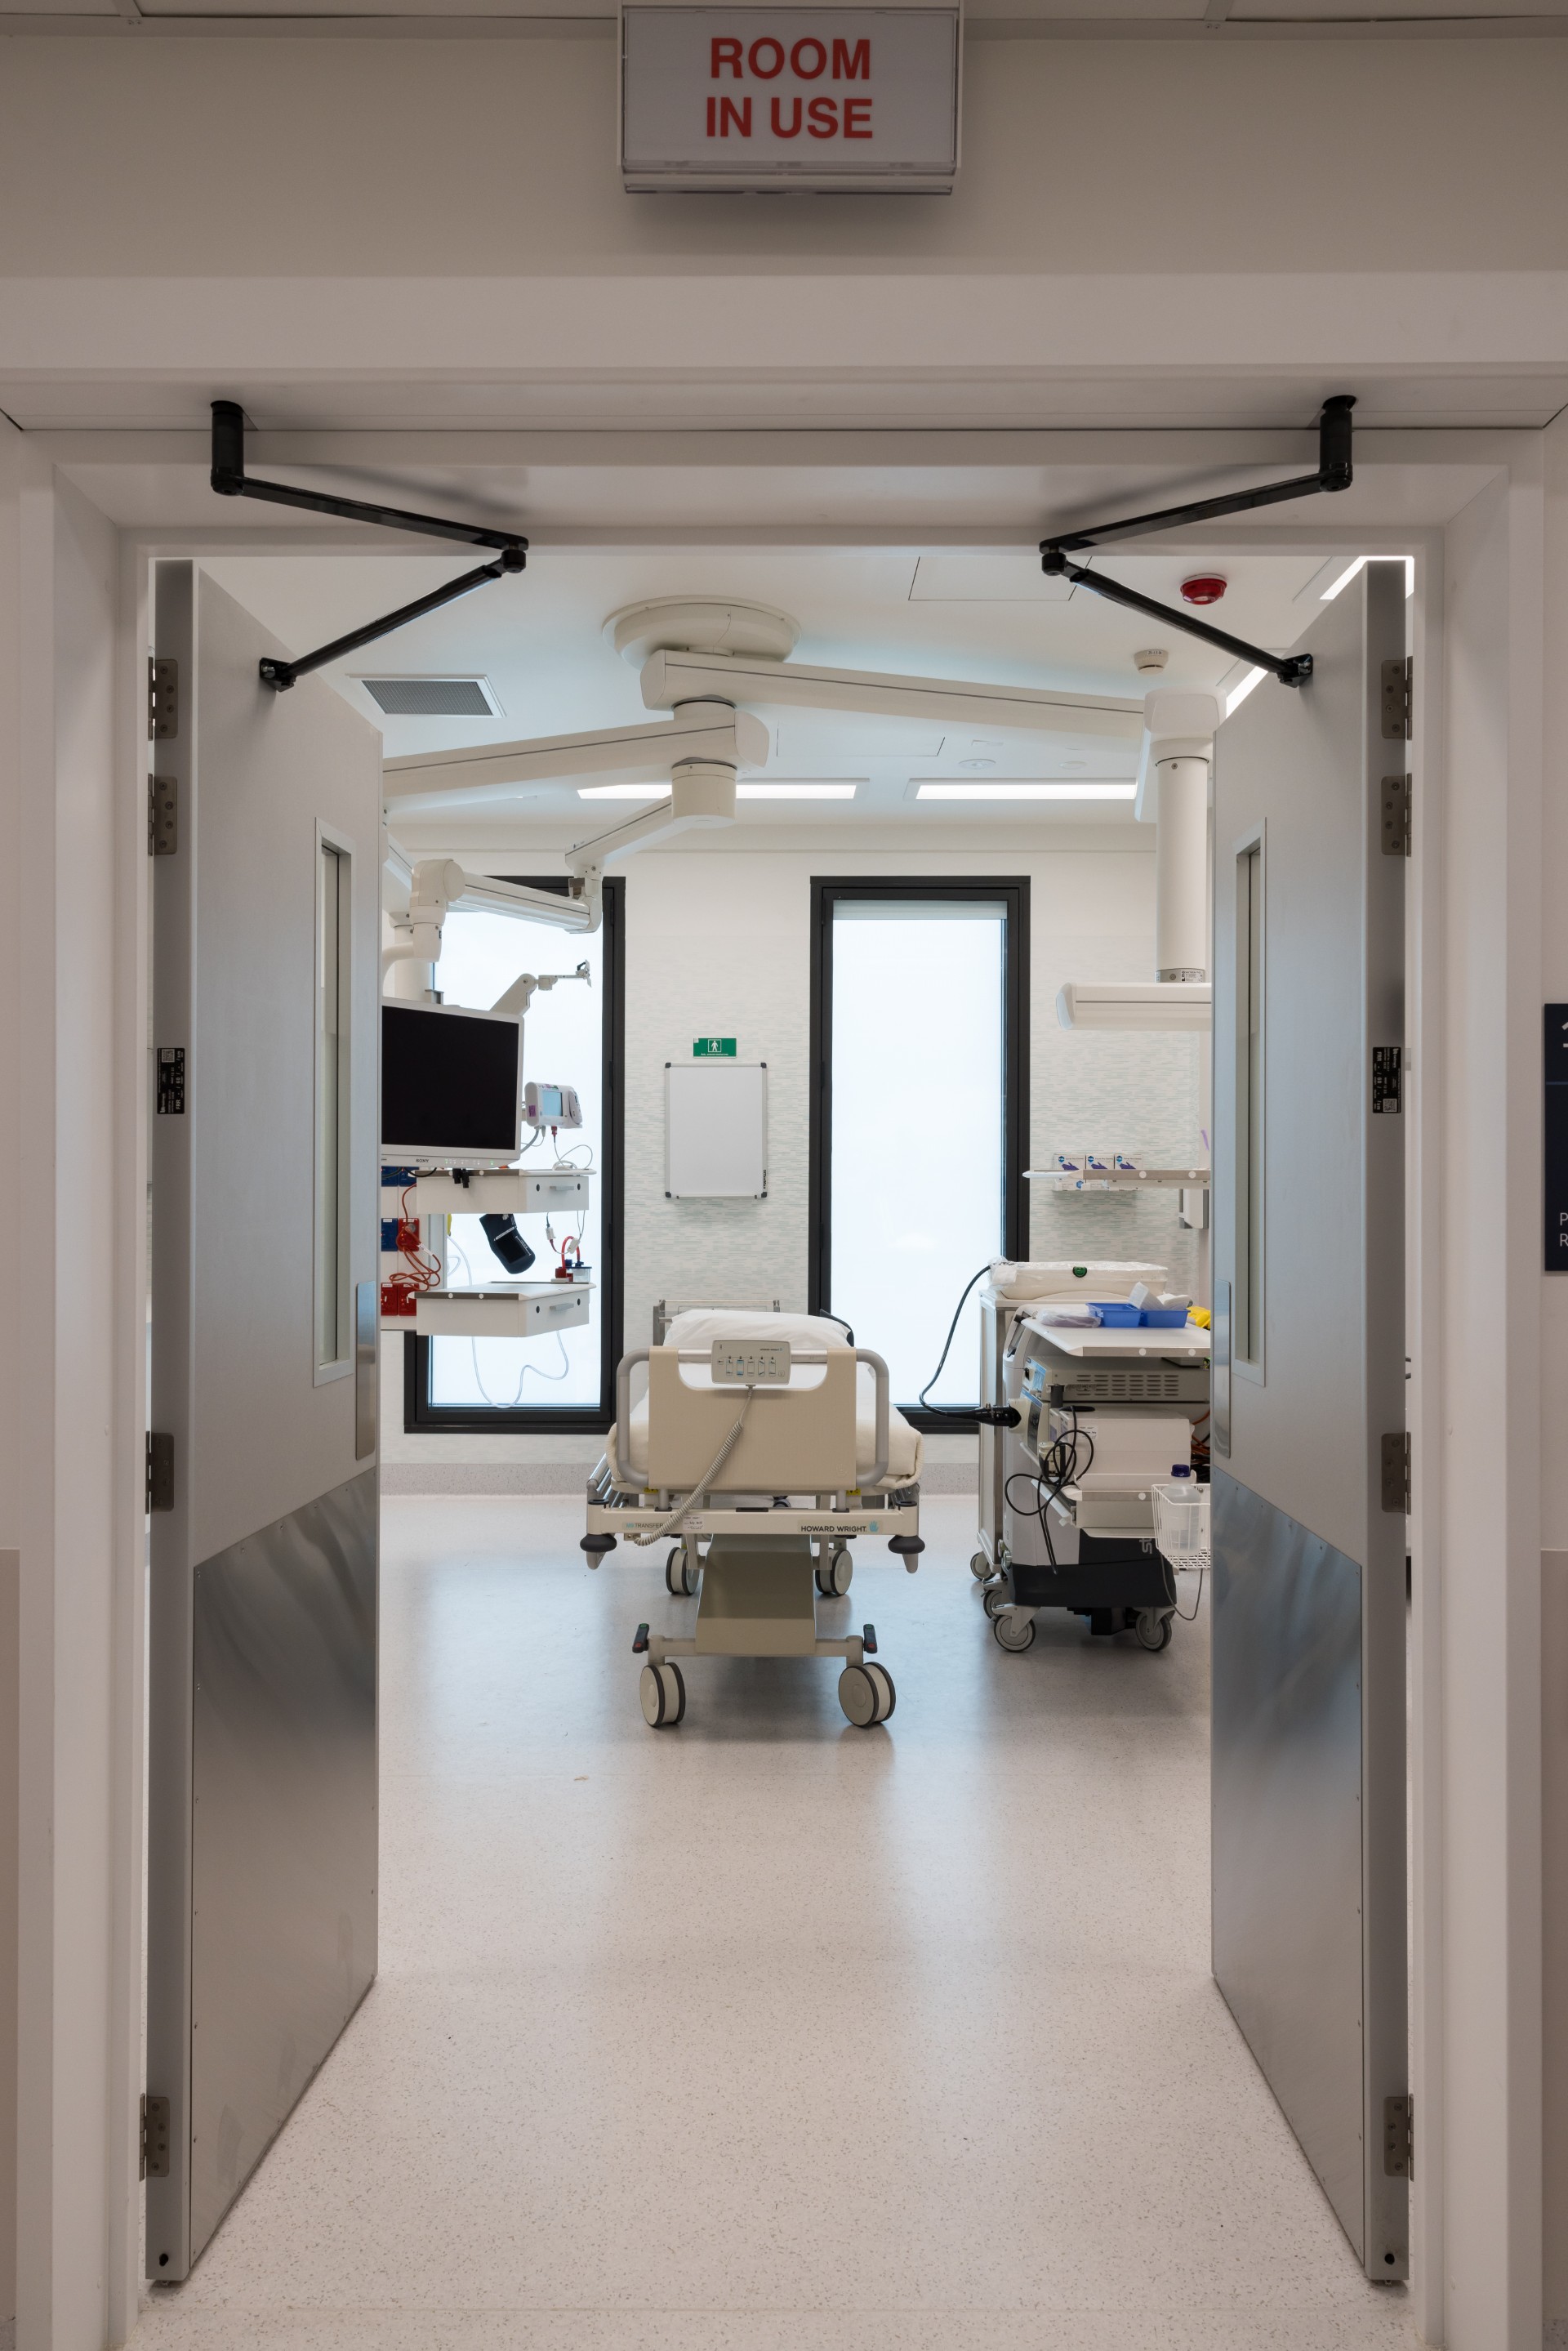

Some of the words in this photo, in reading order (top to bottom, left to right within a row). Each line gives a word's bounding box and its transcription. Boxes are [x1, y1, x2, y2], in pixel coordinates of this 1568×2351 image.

[710, 37, 871, 79] ROOM
[706, 97, 752, 137] IN
[770, 97, 873, 138] USE
